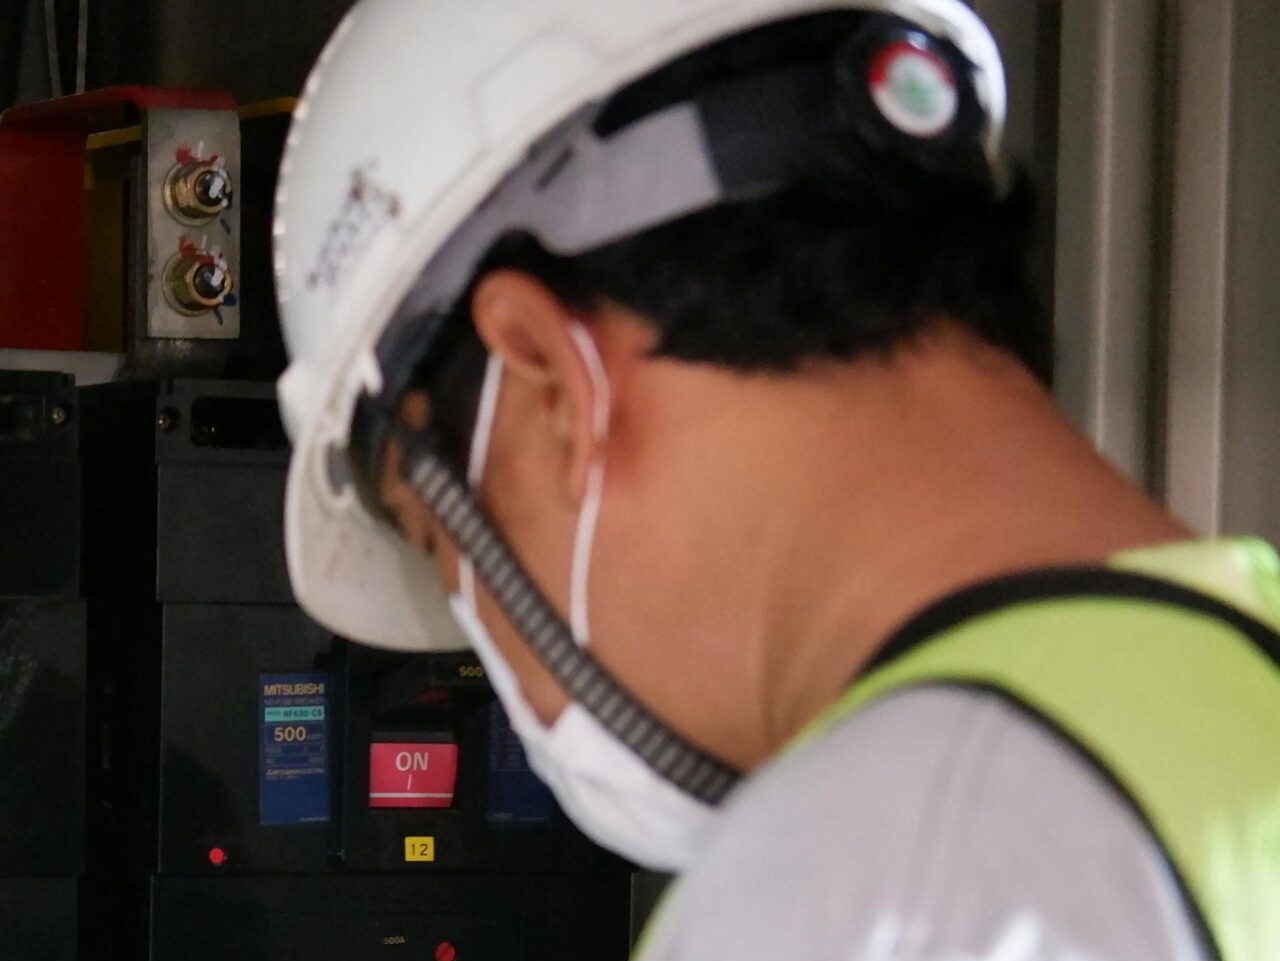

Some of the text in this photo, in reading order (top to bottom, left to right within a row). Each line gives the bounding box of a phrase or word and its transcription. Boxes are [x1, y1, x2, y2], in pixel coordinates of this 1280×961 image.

[264, 683, 324, 696] MITSUBISHI
[274, 726, 306, 741] 500
[395, 751, 429, 771] ON
[411, 844, 428, 856] 12
